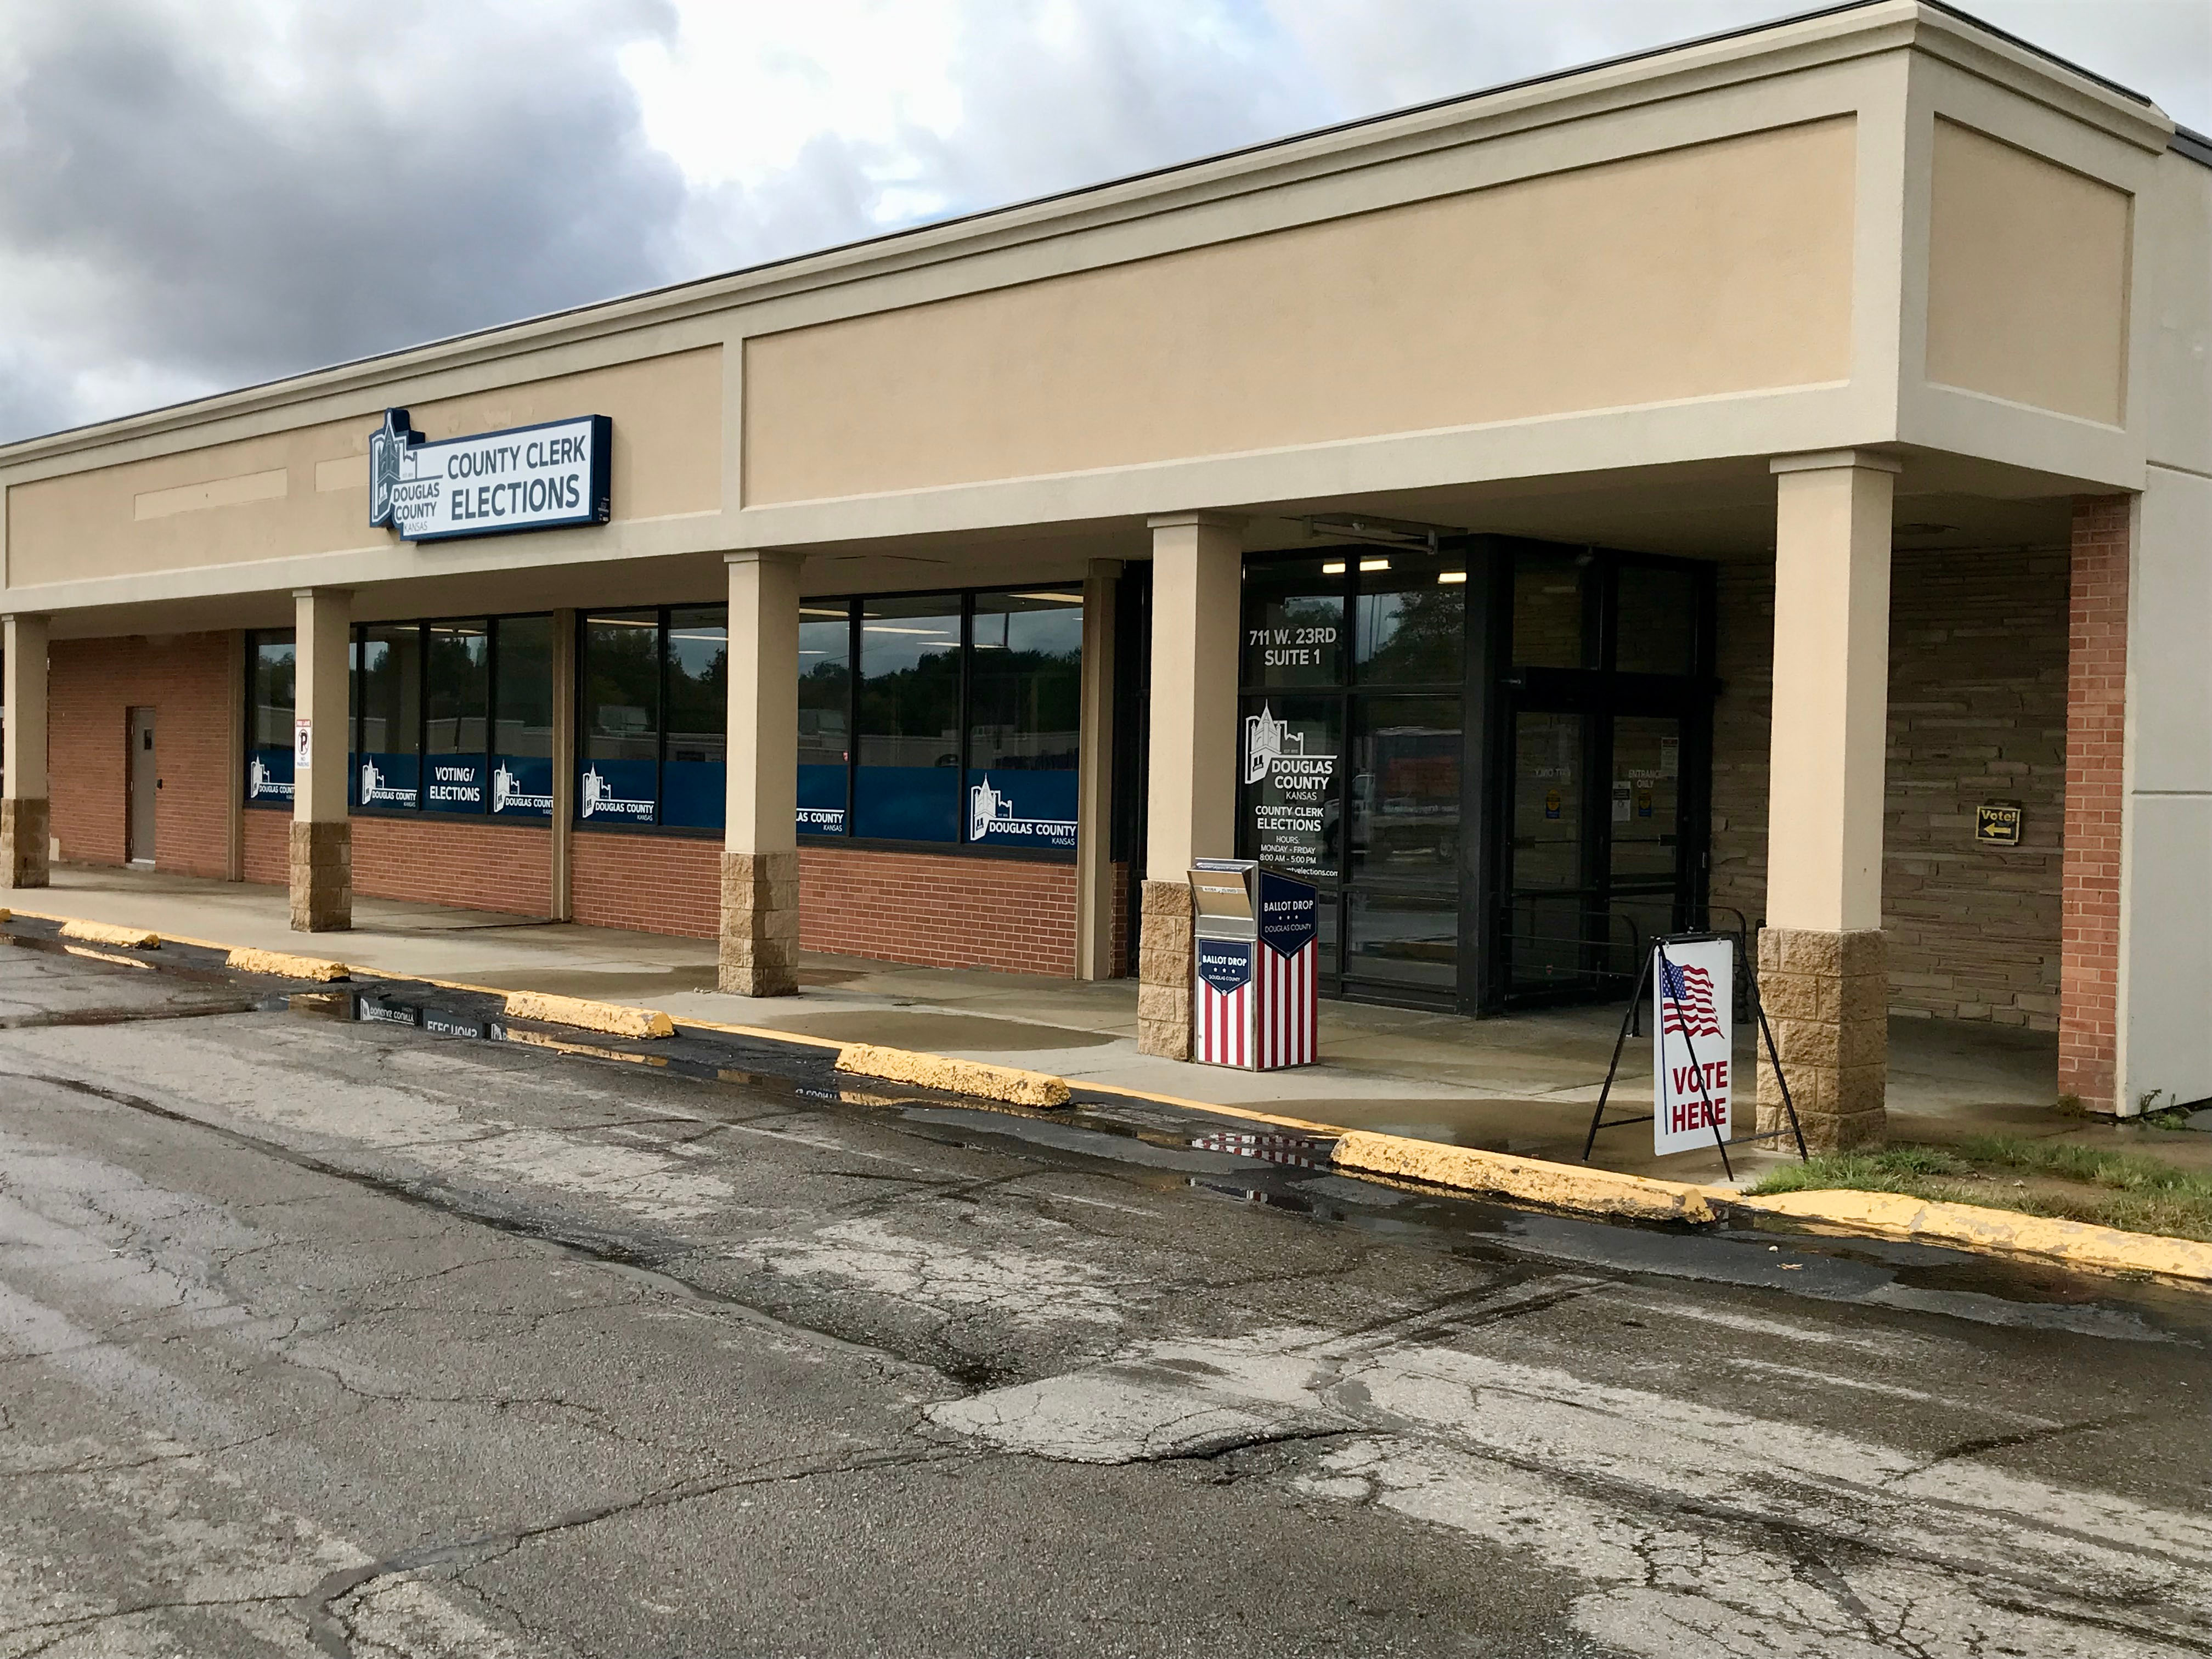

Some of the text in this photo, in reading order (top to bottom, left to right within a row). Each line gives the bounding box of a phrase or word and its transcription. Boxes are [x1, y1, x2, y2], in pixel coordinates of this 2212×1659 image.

[448, 435, 586, 479] COUNTY CLERK
[393, 482, 440, 503] DOUGLAS
[452, 474, 580, 521] ELECTIONS
[396, 501, 437, 520] COUNTY
[404, 521, 427, 532] KANSAS
[1250, 627, 1336, 645] 711 W. 23RD
[1265, 648, 1320, 665] SUITE 1
[1272, 760, 1333, 774] DOUGLAS
[436, 767, 475, 781] VOTING/
[1274, 776, 1329, 790] COUNTY
[259, 785, 279, 794] DOUGLAS
[372, 791, 394, 800] DOUGLAS
[430, 785, 480, 802] ELECTIONS
[1285, 792, 1317, 800] KANSAS
[505, 797, 553, 809] DOUGLAS COUNT
[595, 802, 654, 814] DOUGLAS COUNTY
[1255, 805, 1324, 817] COUNTY CLERK
[1981, 810, 2016, 822] Vote!
[811, 812, 843, 824] COUNTY
[989, 822, 1076, 837] DOUGLAS COUNTY
[1257, 818, 1321, 832] ELECTIONS
[1276, 836, 1300, 844] HOURS:
[1261, 844, 1288, 853] MONDAY
[1293, 846, 1316, 854] FRIDAY
[1260, 854, 1273, 862] 8:00
[1264, 900, 1313, 912] BALLOT DROP
[1265, 923, 1312, 933] DOUGLAS COUNTY
[1202, 955, 1247, 967] BALLOT DROP
[1673, 1061, 1728, 1095] VOTE
[1672, 1097, 1726, 1133] HERE
